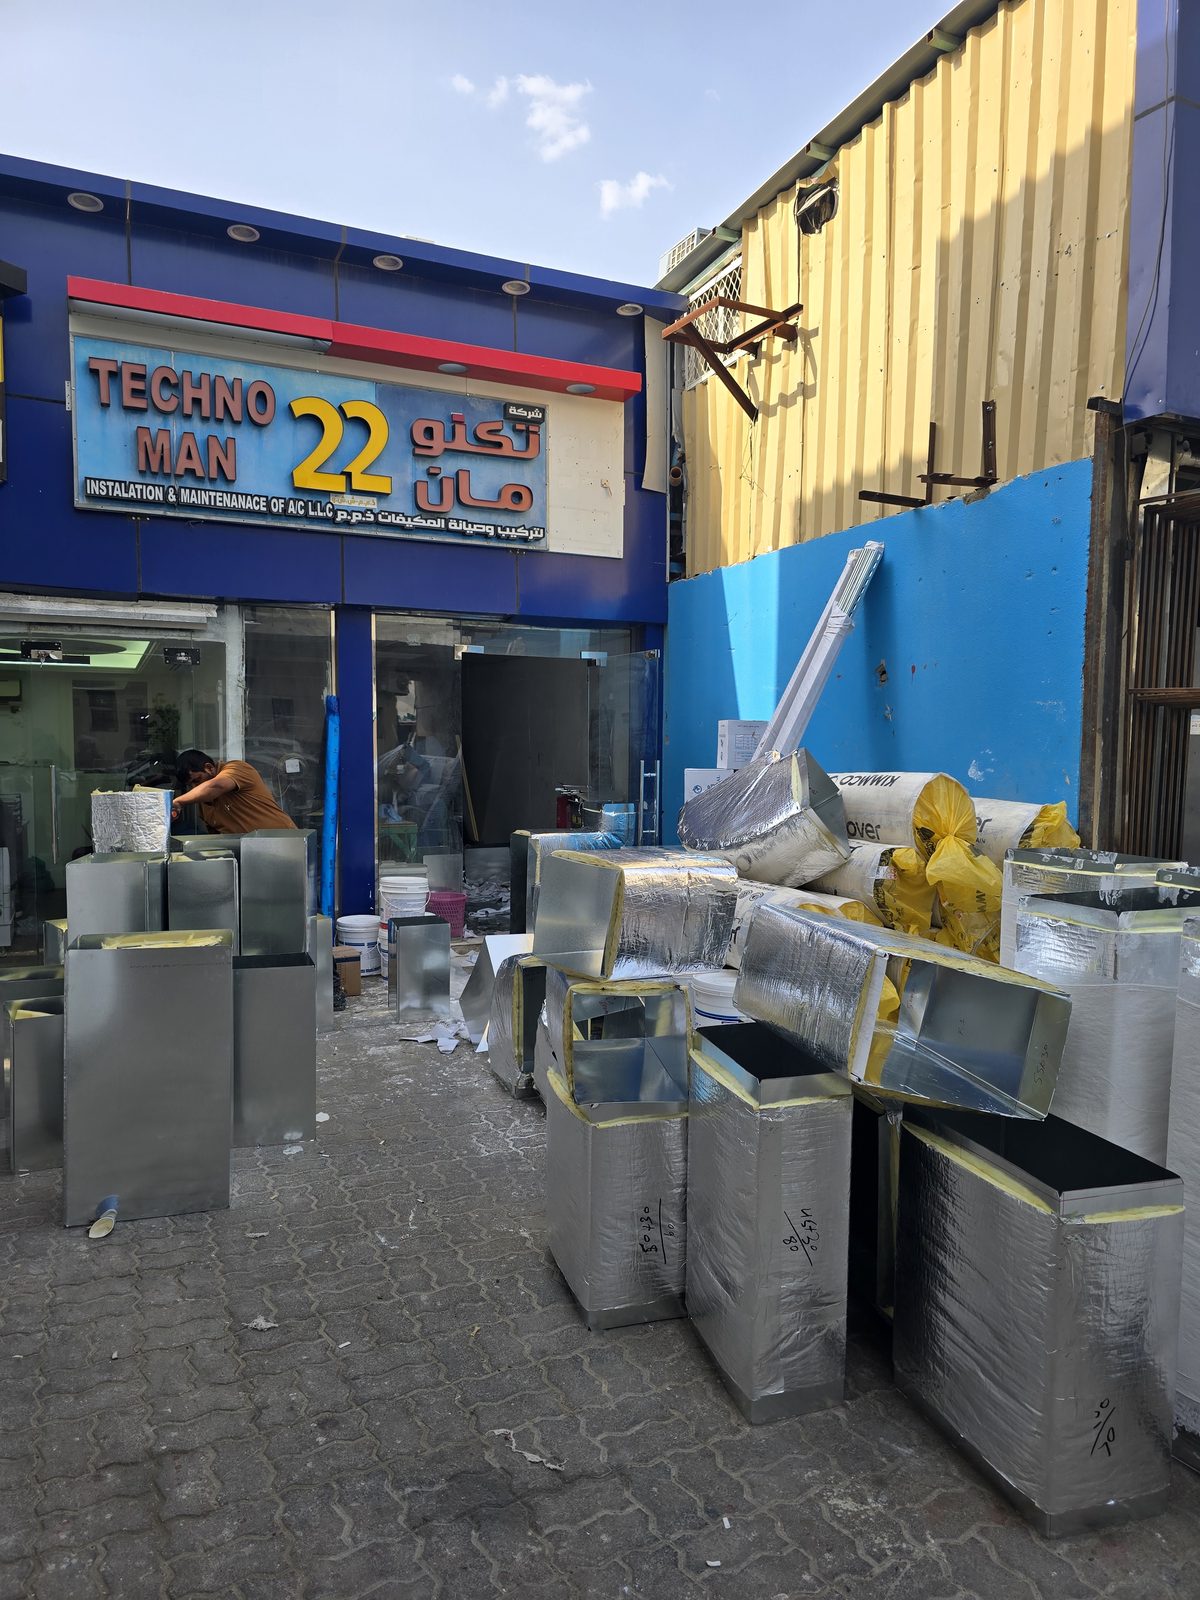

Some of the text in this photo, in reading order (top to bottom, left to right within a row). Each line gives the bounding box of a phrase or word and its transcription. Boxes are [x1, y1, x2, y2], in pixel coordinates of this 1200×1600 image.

[88, 356, 276, 426] TECHNO
[508, 405, 542, 419] شركة
[136, 426, 236, 481] MAN
[288, 396, 392, 496] 22
[410, 412, 540, 460] تكنو
[86, 479, 333, 517] INSTALATION & MAINTENANACE OF A/C L.L.C
[414, 466, 533, 513] مان
[378, 511, 445, 528] المكيفات
[448, 519, 495, 536] وصيانة
[497, 525, 544, 541] لتركيب
[840, 775, 900, 788] KIMMCO
